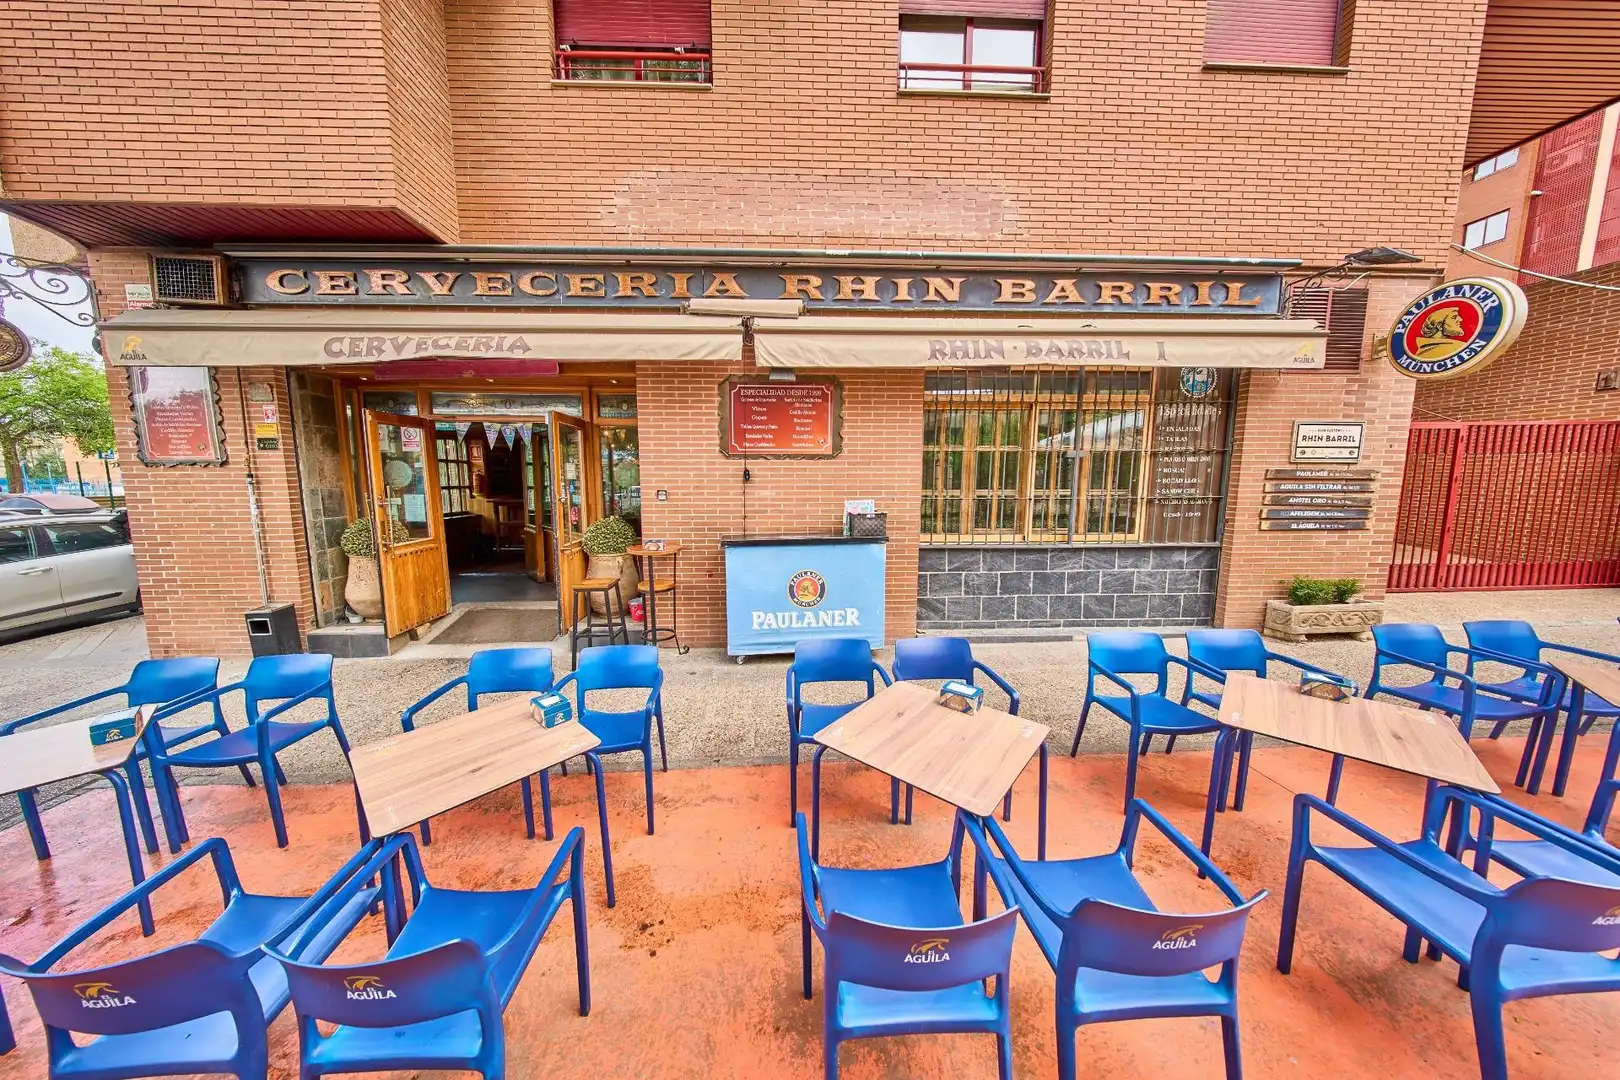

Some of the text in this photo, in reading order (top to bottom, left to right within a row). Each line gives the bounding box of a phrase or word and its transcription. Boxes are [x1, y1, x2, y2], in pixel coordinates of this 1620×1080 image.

[266, 269, 1262, 307] CERVECERIA RHIN BARRIL
[1394, 284, 1500, 334] PAULANER
[324, 336, 532, 358] CERVECERIA
[927, 340, 1005, 361] RHIN
[1024, 340, 1131, 361] BARRIL
[1397, 338, 1488, 373] MÜNCHEN
[1325, 435, 1356, 443] BARRIL
[790, 571, 824, 586] PAULANER
[751, 607, 861, 630] PAULANER
